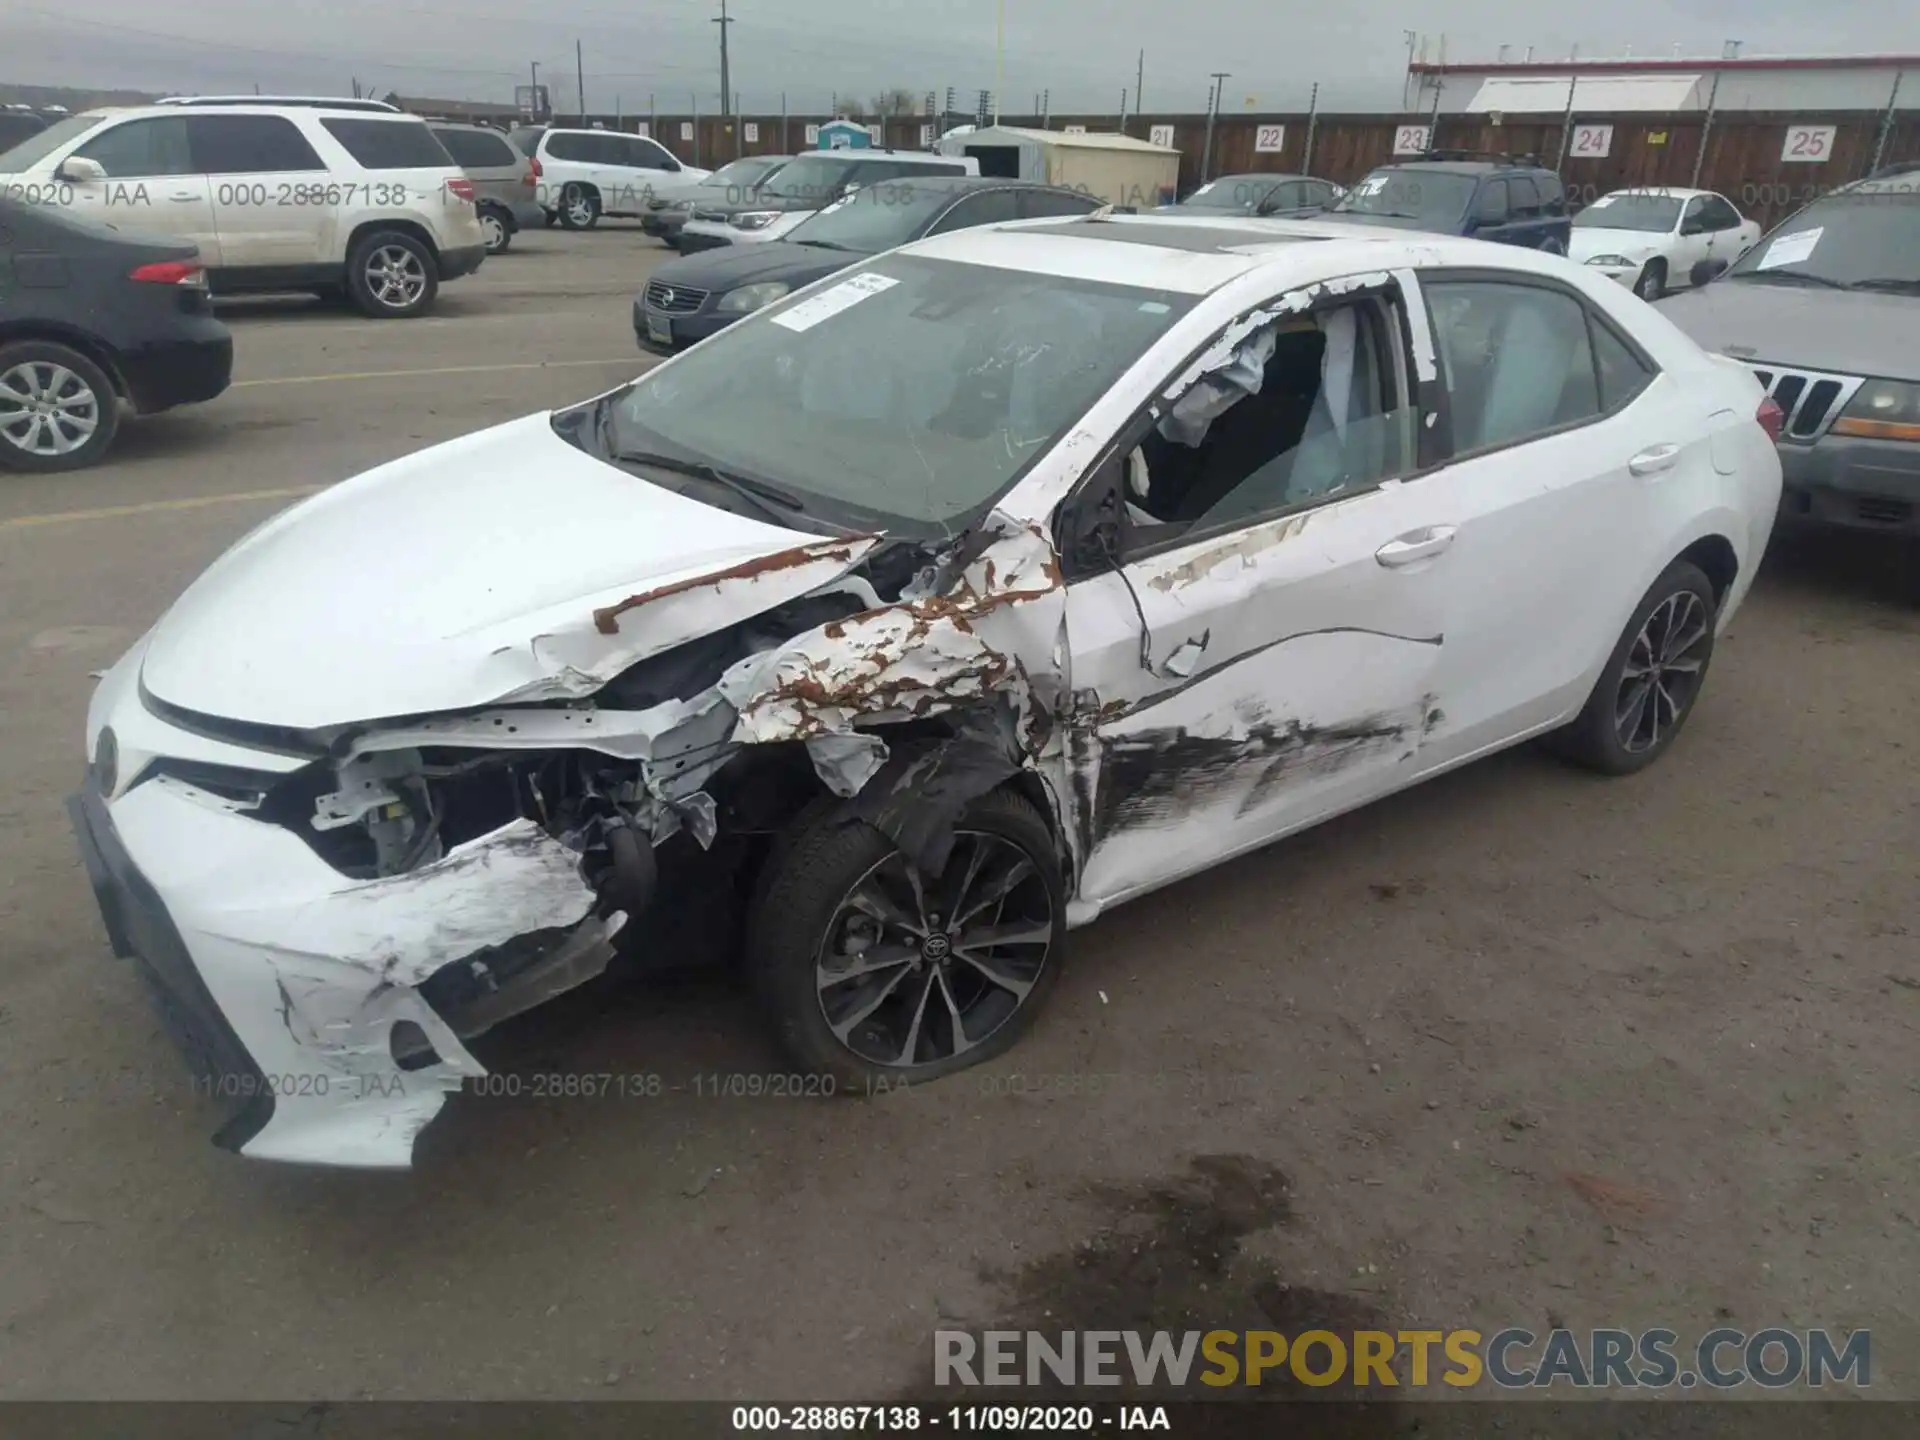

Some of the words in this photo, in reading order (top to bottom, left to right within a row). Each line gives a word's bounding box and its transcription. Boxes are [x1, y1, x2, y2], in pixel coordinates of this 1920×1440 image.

[1259, 128, 1279, 148] 22
[1399, 129, 1423, 150] 23
[1577, 129, 1605, 151] 24
[1793, 130, 1828, 156] 25
